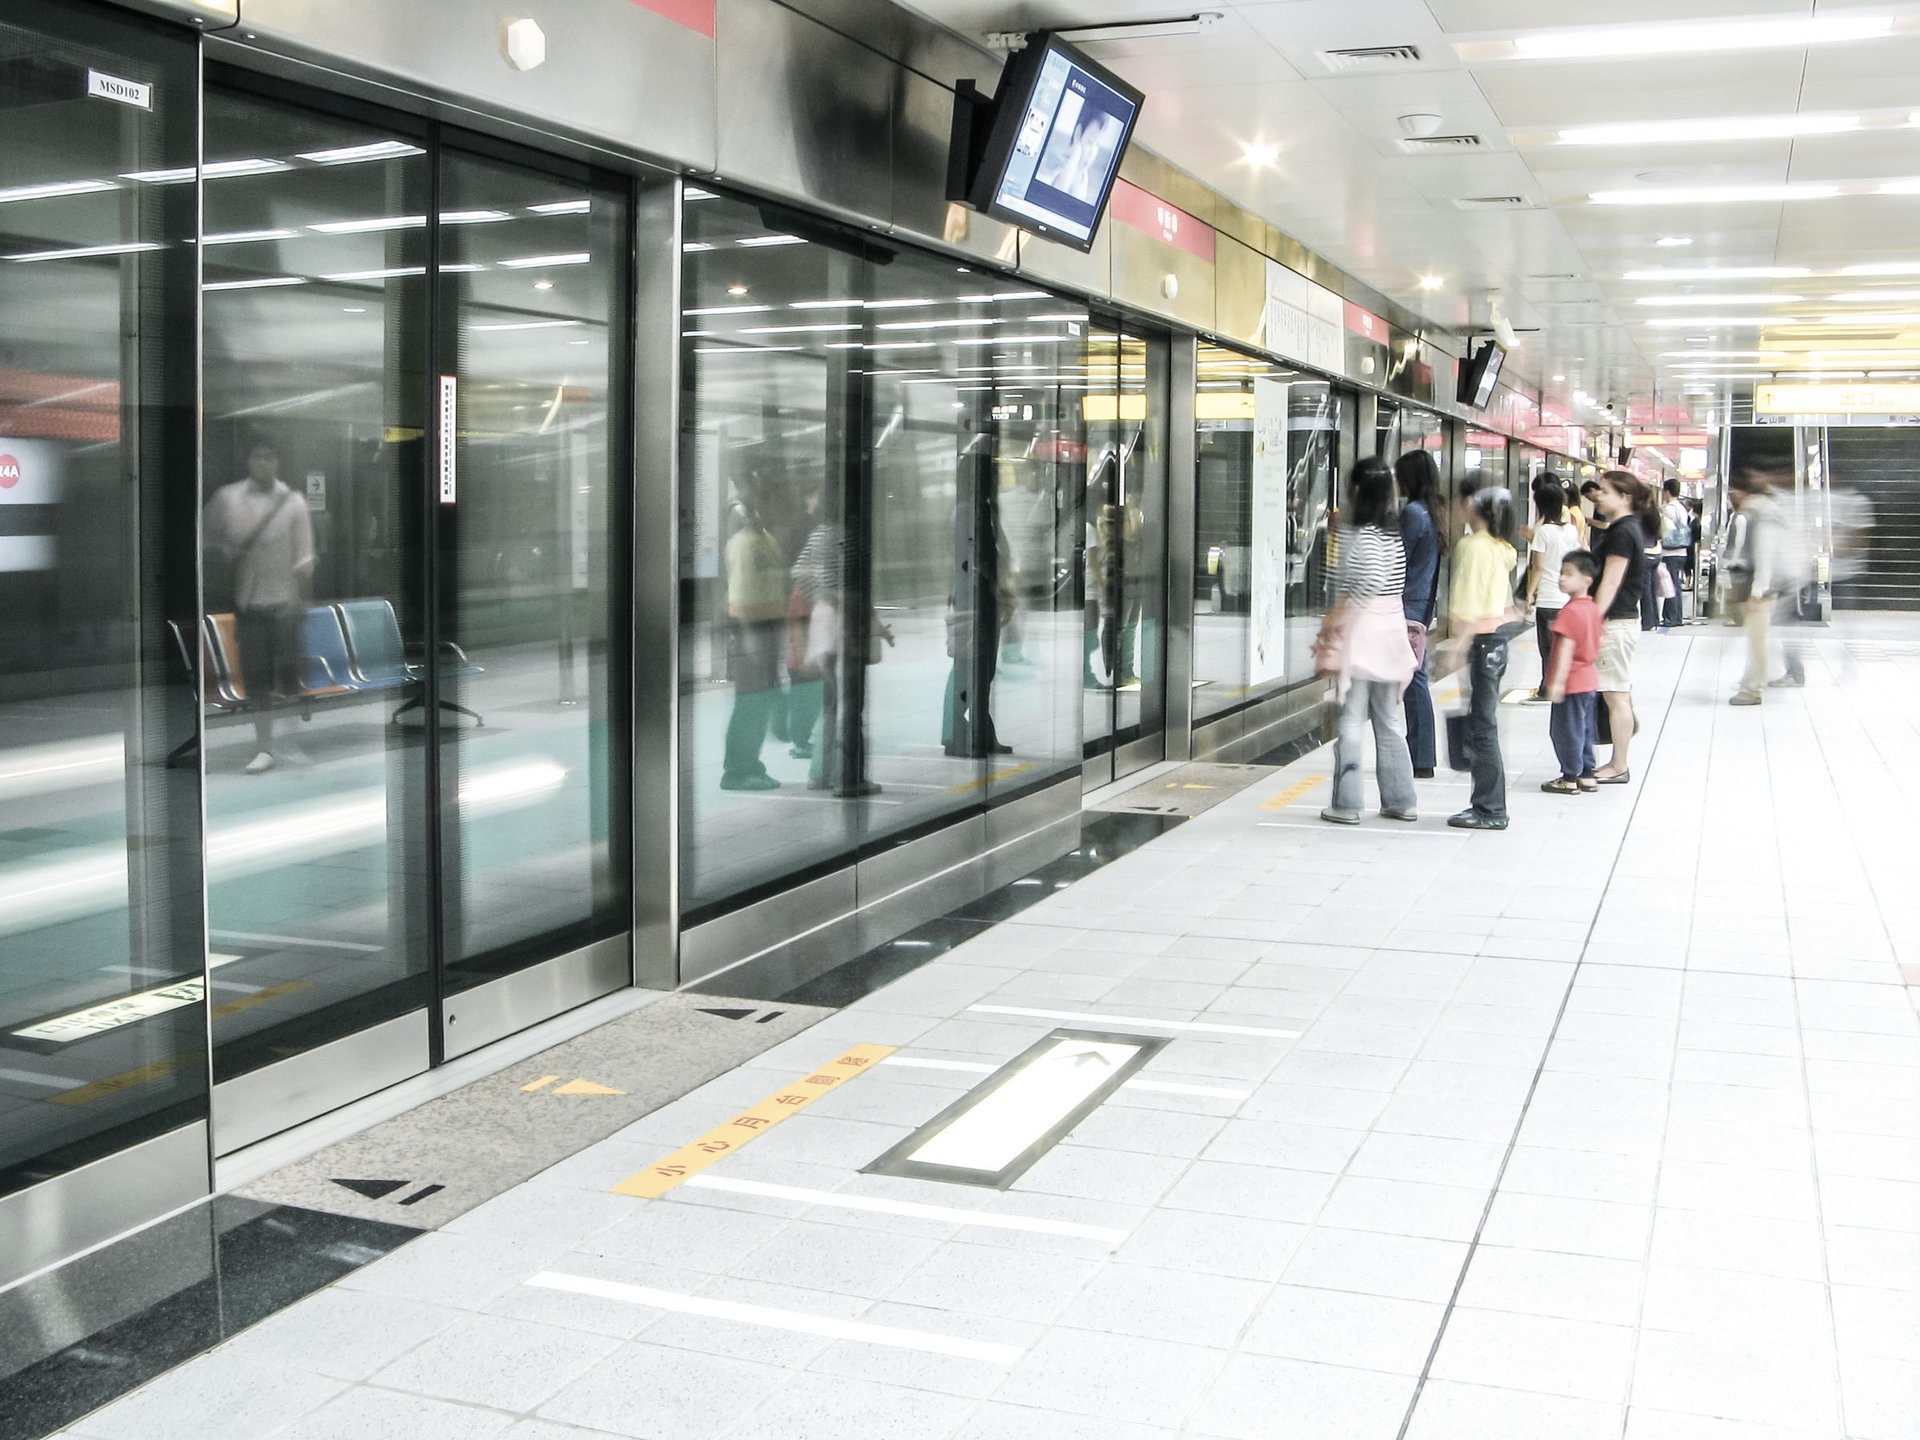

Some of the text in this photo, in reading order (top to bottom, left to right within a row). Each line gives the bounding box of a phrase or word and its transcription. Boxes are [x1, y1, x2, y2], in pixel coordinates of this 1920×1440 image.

[100, 80, 140, 100] MSD102
[655, 1055, 870, 1178] 小心月台間隙
